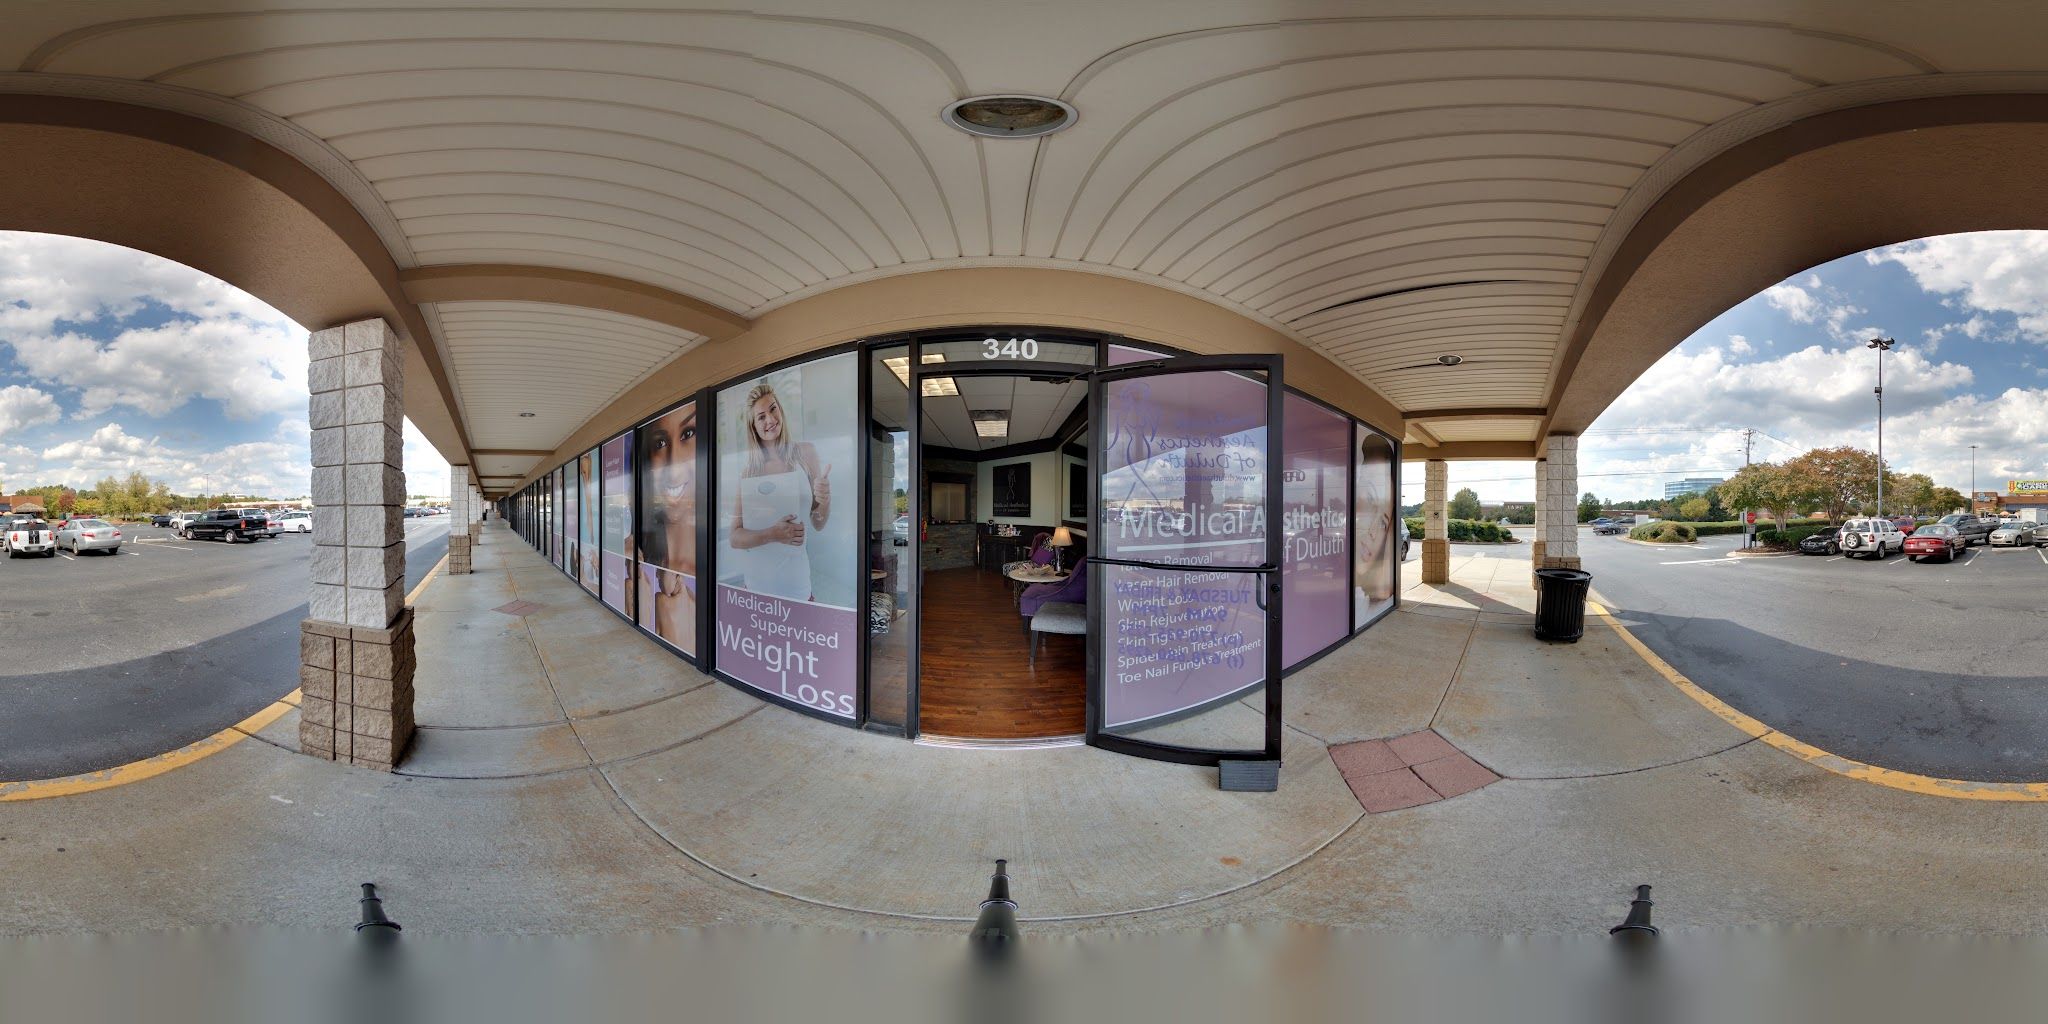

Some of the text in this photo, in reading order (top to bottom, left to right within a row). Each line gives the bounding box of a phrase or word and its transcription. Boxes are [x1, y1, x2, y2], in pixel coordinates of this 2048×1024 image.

[982, 338, 1039, 360] 340
[1119, 502, 1243, 539] Medical
[1164, 551, 1214, 566] Removal
[1296, 534, 1344, 561] Duluth
[1157, 574, 1182, 588] Hair
[1184, 571, 1229, 586] Removal
[726, 590, 791, 622] Medically
[750, 613, 838, 649] Supervised
[1118, 617, 1146, 632] Skin
[1149, 624, 1213, 646] Tighening
[719, 620, 819, 678] Weight
[1117, 673, 1142, 685] Toe
[1145, 664, 1169, 679] Nail
[1215, 639, 1262, 658] Treatment
[781, 670, 855, 715] Loss
